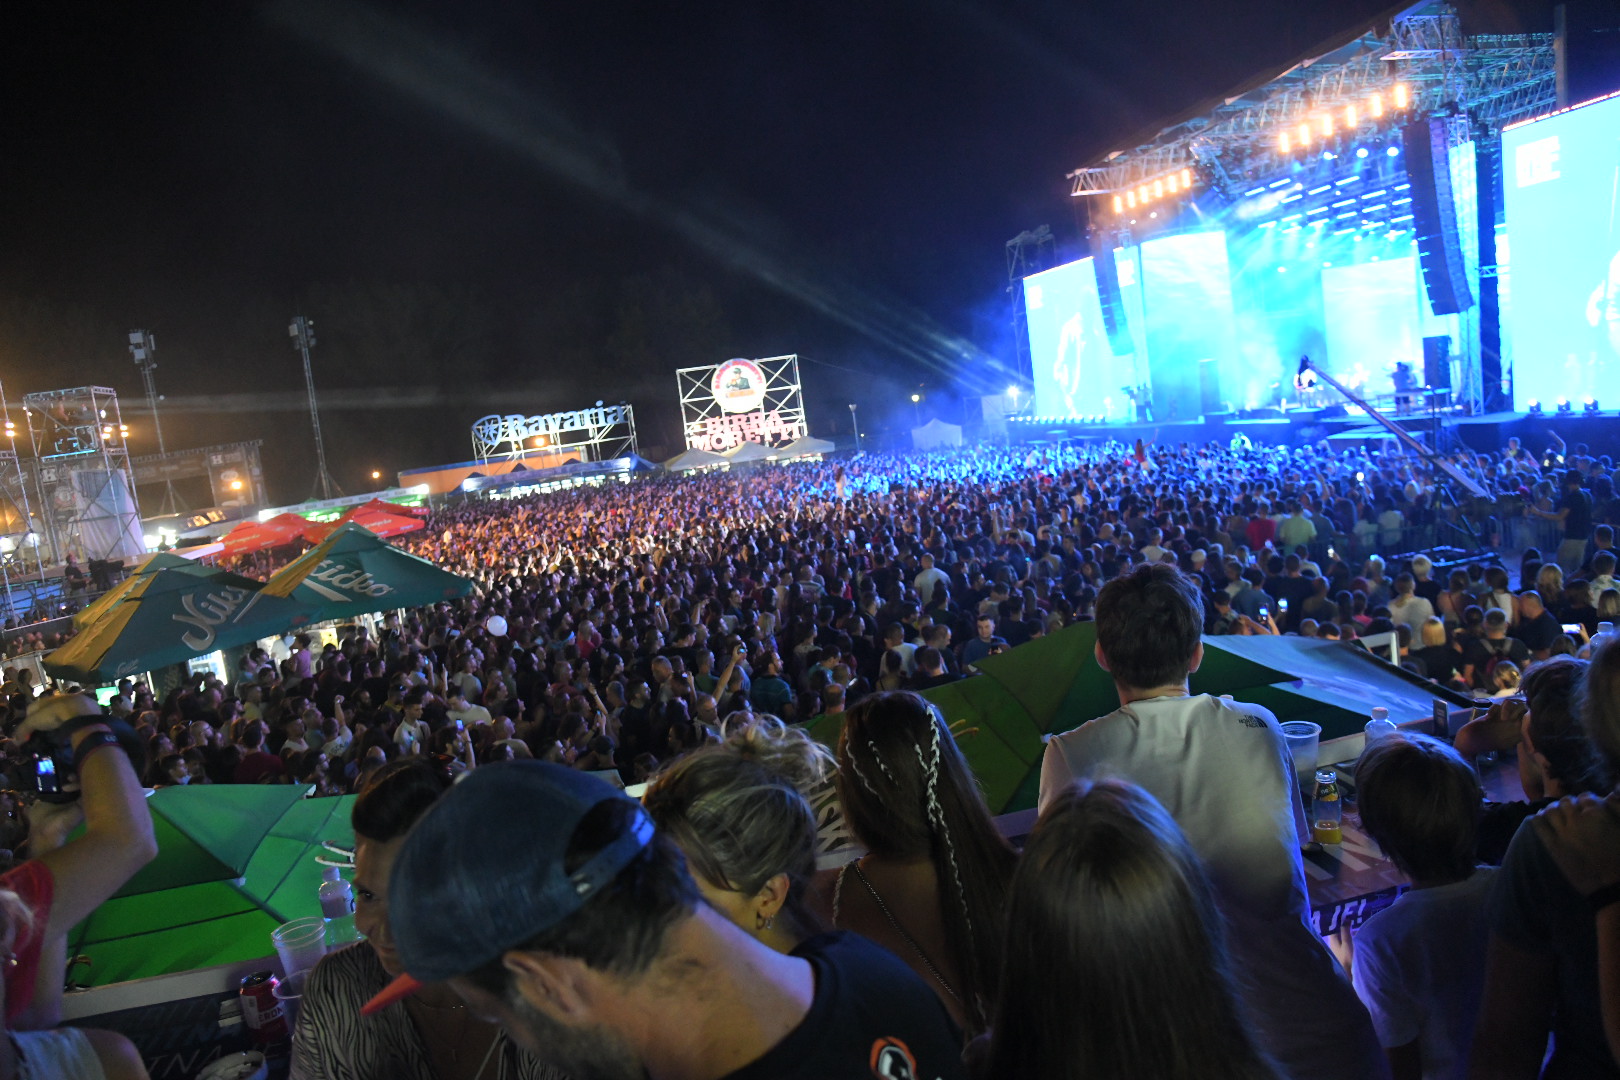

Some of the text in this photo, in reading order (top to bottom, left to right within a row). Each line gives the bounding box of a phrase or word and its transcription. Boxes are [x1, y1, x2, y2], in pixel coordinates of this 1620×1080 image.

[504, 400, 628, 440] Bavaria
[705, 409, 785, 436] BIRRA
[690, 422, 802, 451] MORETTI
